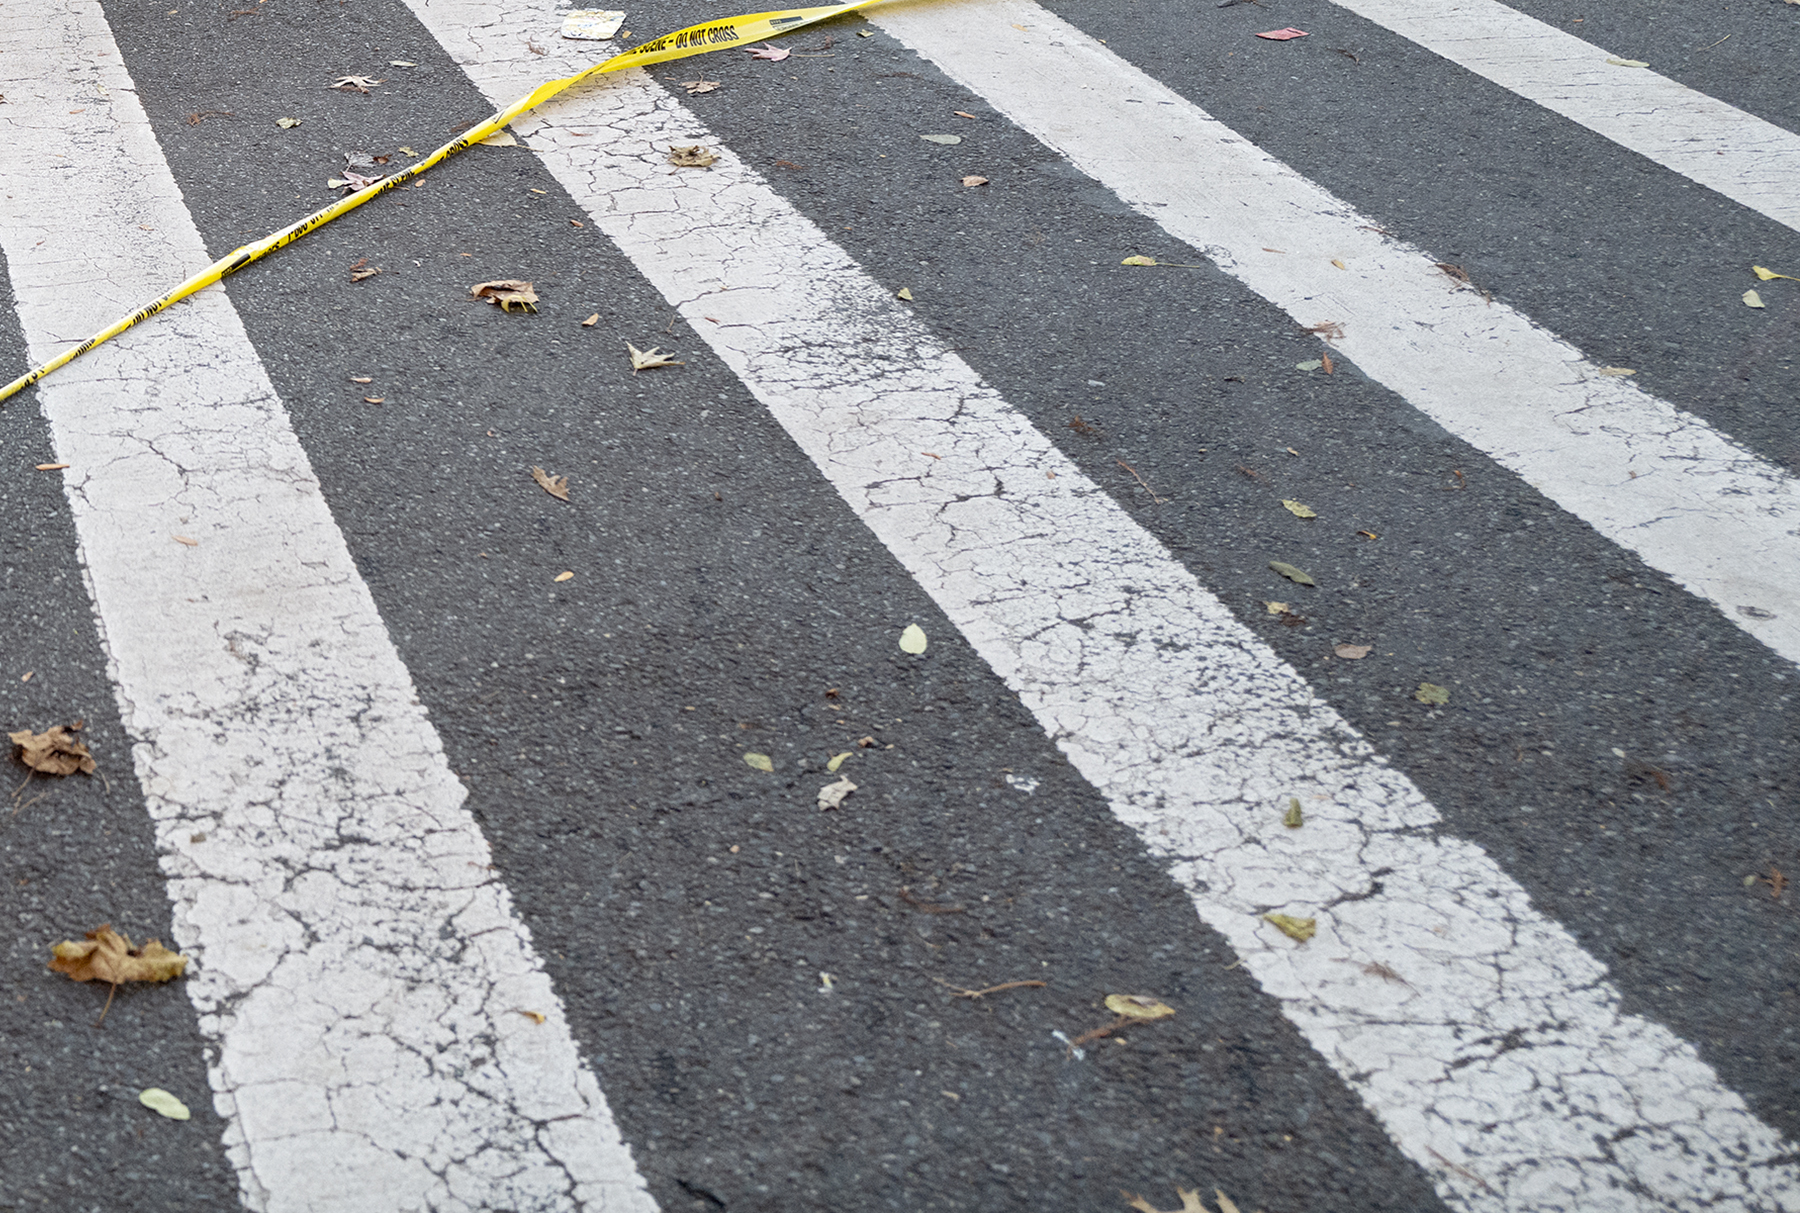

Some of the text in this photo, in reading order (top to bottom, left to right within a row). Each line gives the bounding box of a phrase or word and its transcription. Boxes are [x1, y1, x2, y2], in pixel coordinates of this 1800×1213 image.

[675, 32, 689, 50] DO
[689, 29, 707, 46] NOT
[707, 24, 740, 44] CROSS
